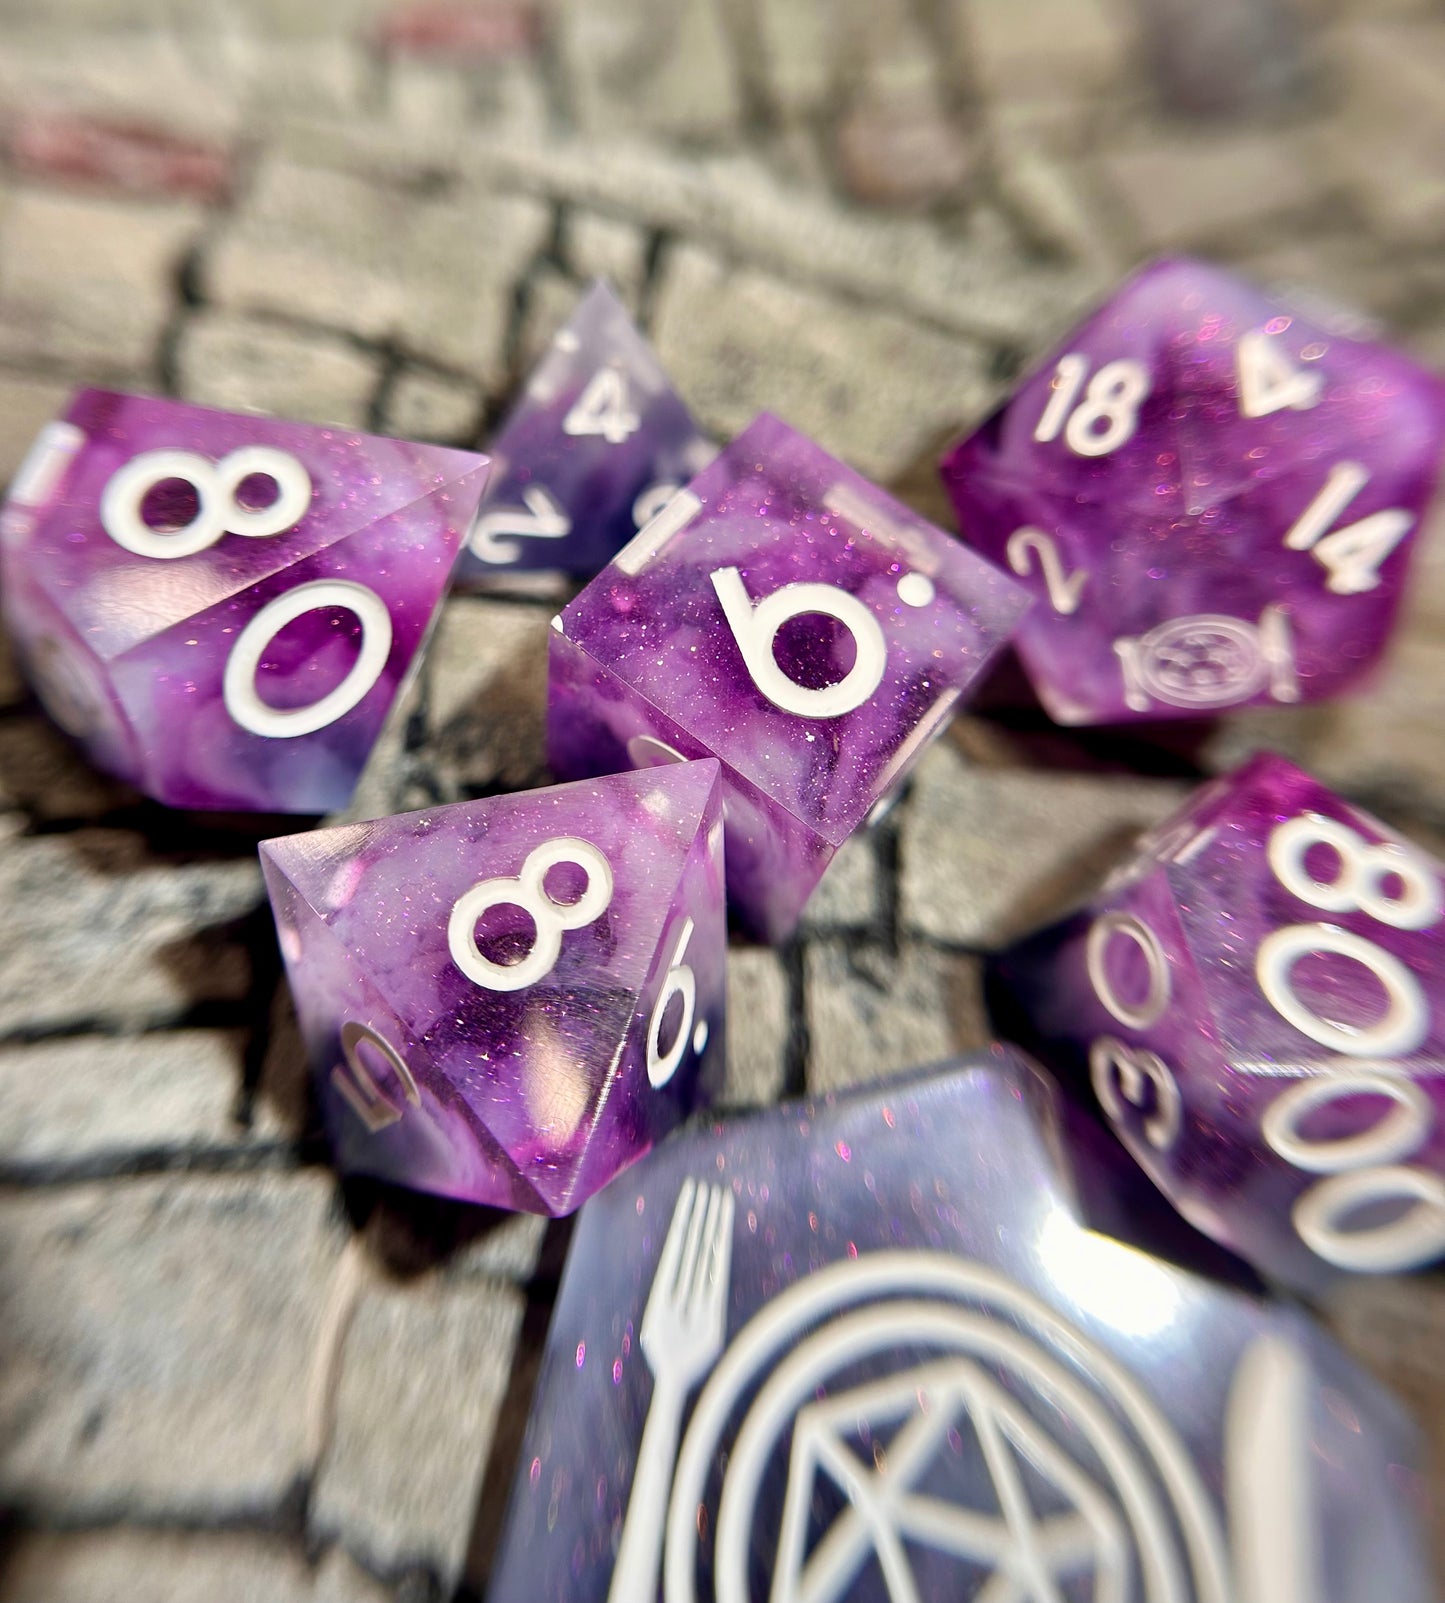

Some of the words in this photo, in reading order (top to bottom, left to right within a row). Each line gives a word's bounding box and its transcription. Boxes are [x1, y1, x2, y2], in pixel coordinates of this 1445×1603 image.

[563, 367, 641, 443] 4
[1034, 353, 1152, 458] 18
[102, 445, 312, 560] 8
[469, 485, 571, 565] 2
[1283, 459, 1415, 596] 14
[1006, 525, 1090, 616] 2
[224, 579, 392, 739] 0
[448, 836, 614, 991] 8
